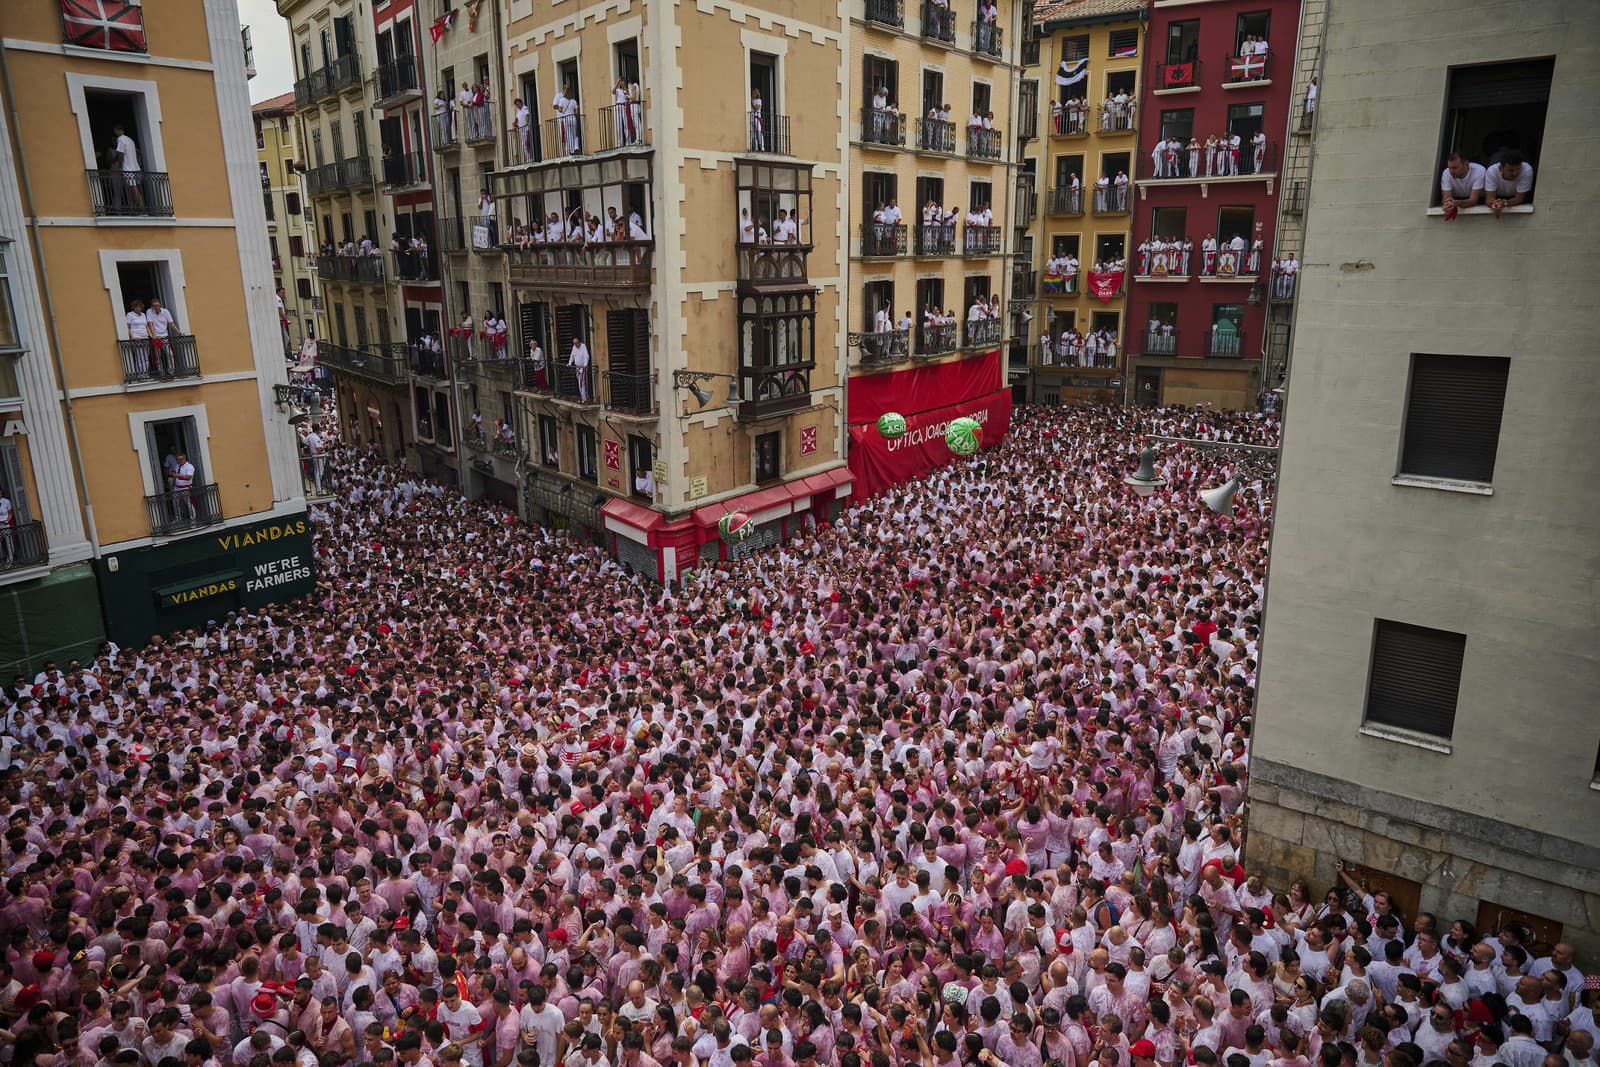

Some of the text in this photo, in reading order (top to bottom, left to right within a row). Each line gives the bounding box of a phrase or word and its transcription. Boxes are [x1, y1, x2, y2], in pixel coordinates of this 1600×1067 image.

[217, 520, 306, 551] VIANDAS
[171, 580, 237, 604] VIANDAS
[246, 567, 311, 593] FARMERS
